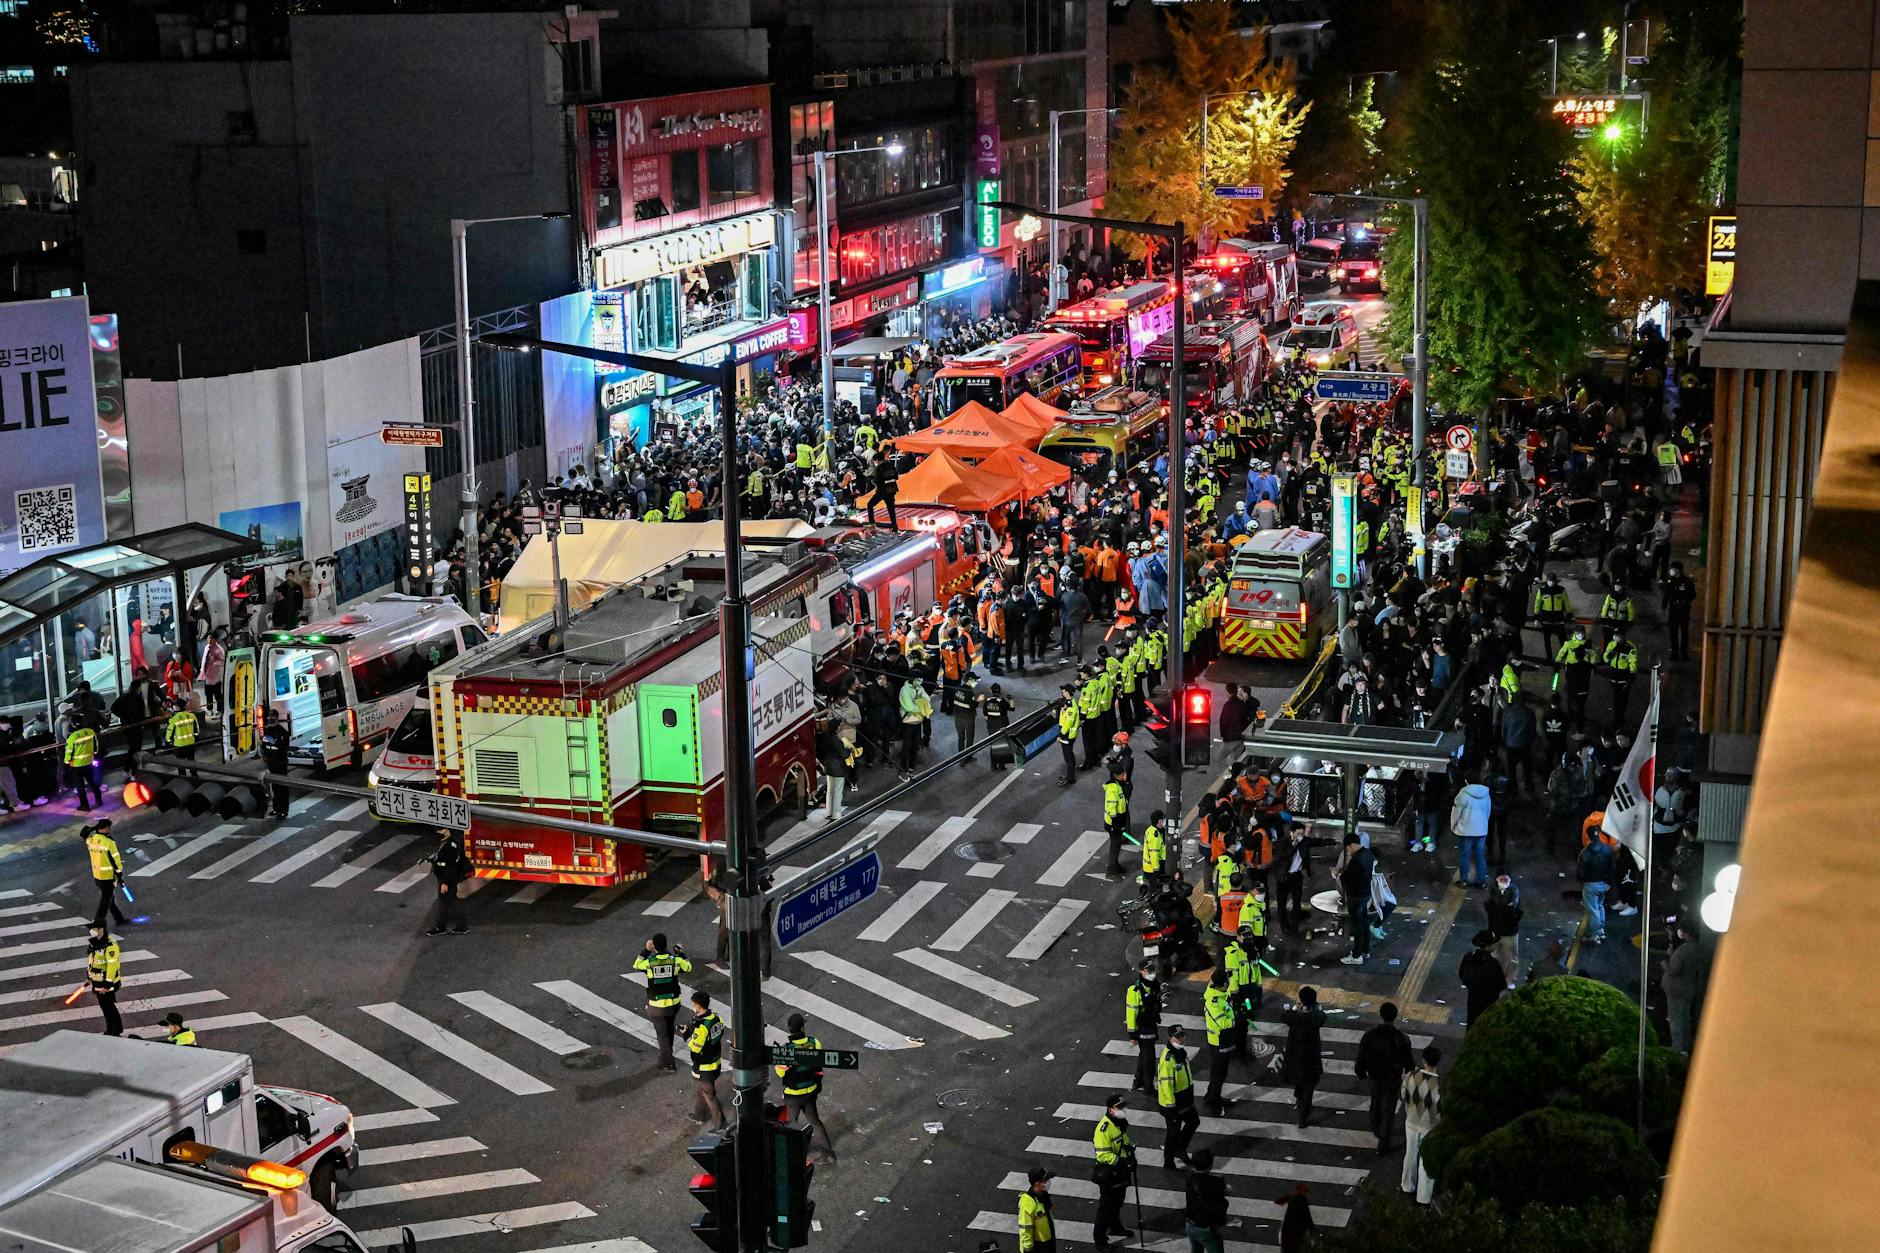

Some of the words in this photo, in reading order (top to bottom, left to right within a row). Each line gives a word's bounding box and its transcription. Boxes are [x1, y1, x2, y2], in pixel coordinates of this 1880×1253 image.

[1713, 233, 1735, 249] 24
[736, 338, 758, 359] EDIYA
[759, 327, 788, 350] COFFEE
[0, 344, 64, 367] 핑크라이
[1361, 383, 1387, 392] 보광로
[409, 494, 417, 504] 4
[1239, 589, 1274, 606] 119
[360, 701, 405, 726] AMBULANCE
[753, 677, 805, 736] 구조통제단
[1410, 761, 1430, 769] 용산구
[379, 789, 405, 815] 직진
[410, 794, 422, 817] 후
[427, 799, 468, 828] 좌회전
[475, 839, 502, 847] 서울특별시
[503, 841, 535, 849] 소방재난본부
[862, 866, 876, 886] 177
[810, 875, 848, 907] 이태원로
[780, 913, 795, 933] 181
[797, 905, 834, 933] Itaewon-ro
